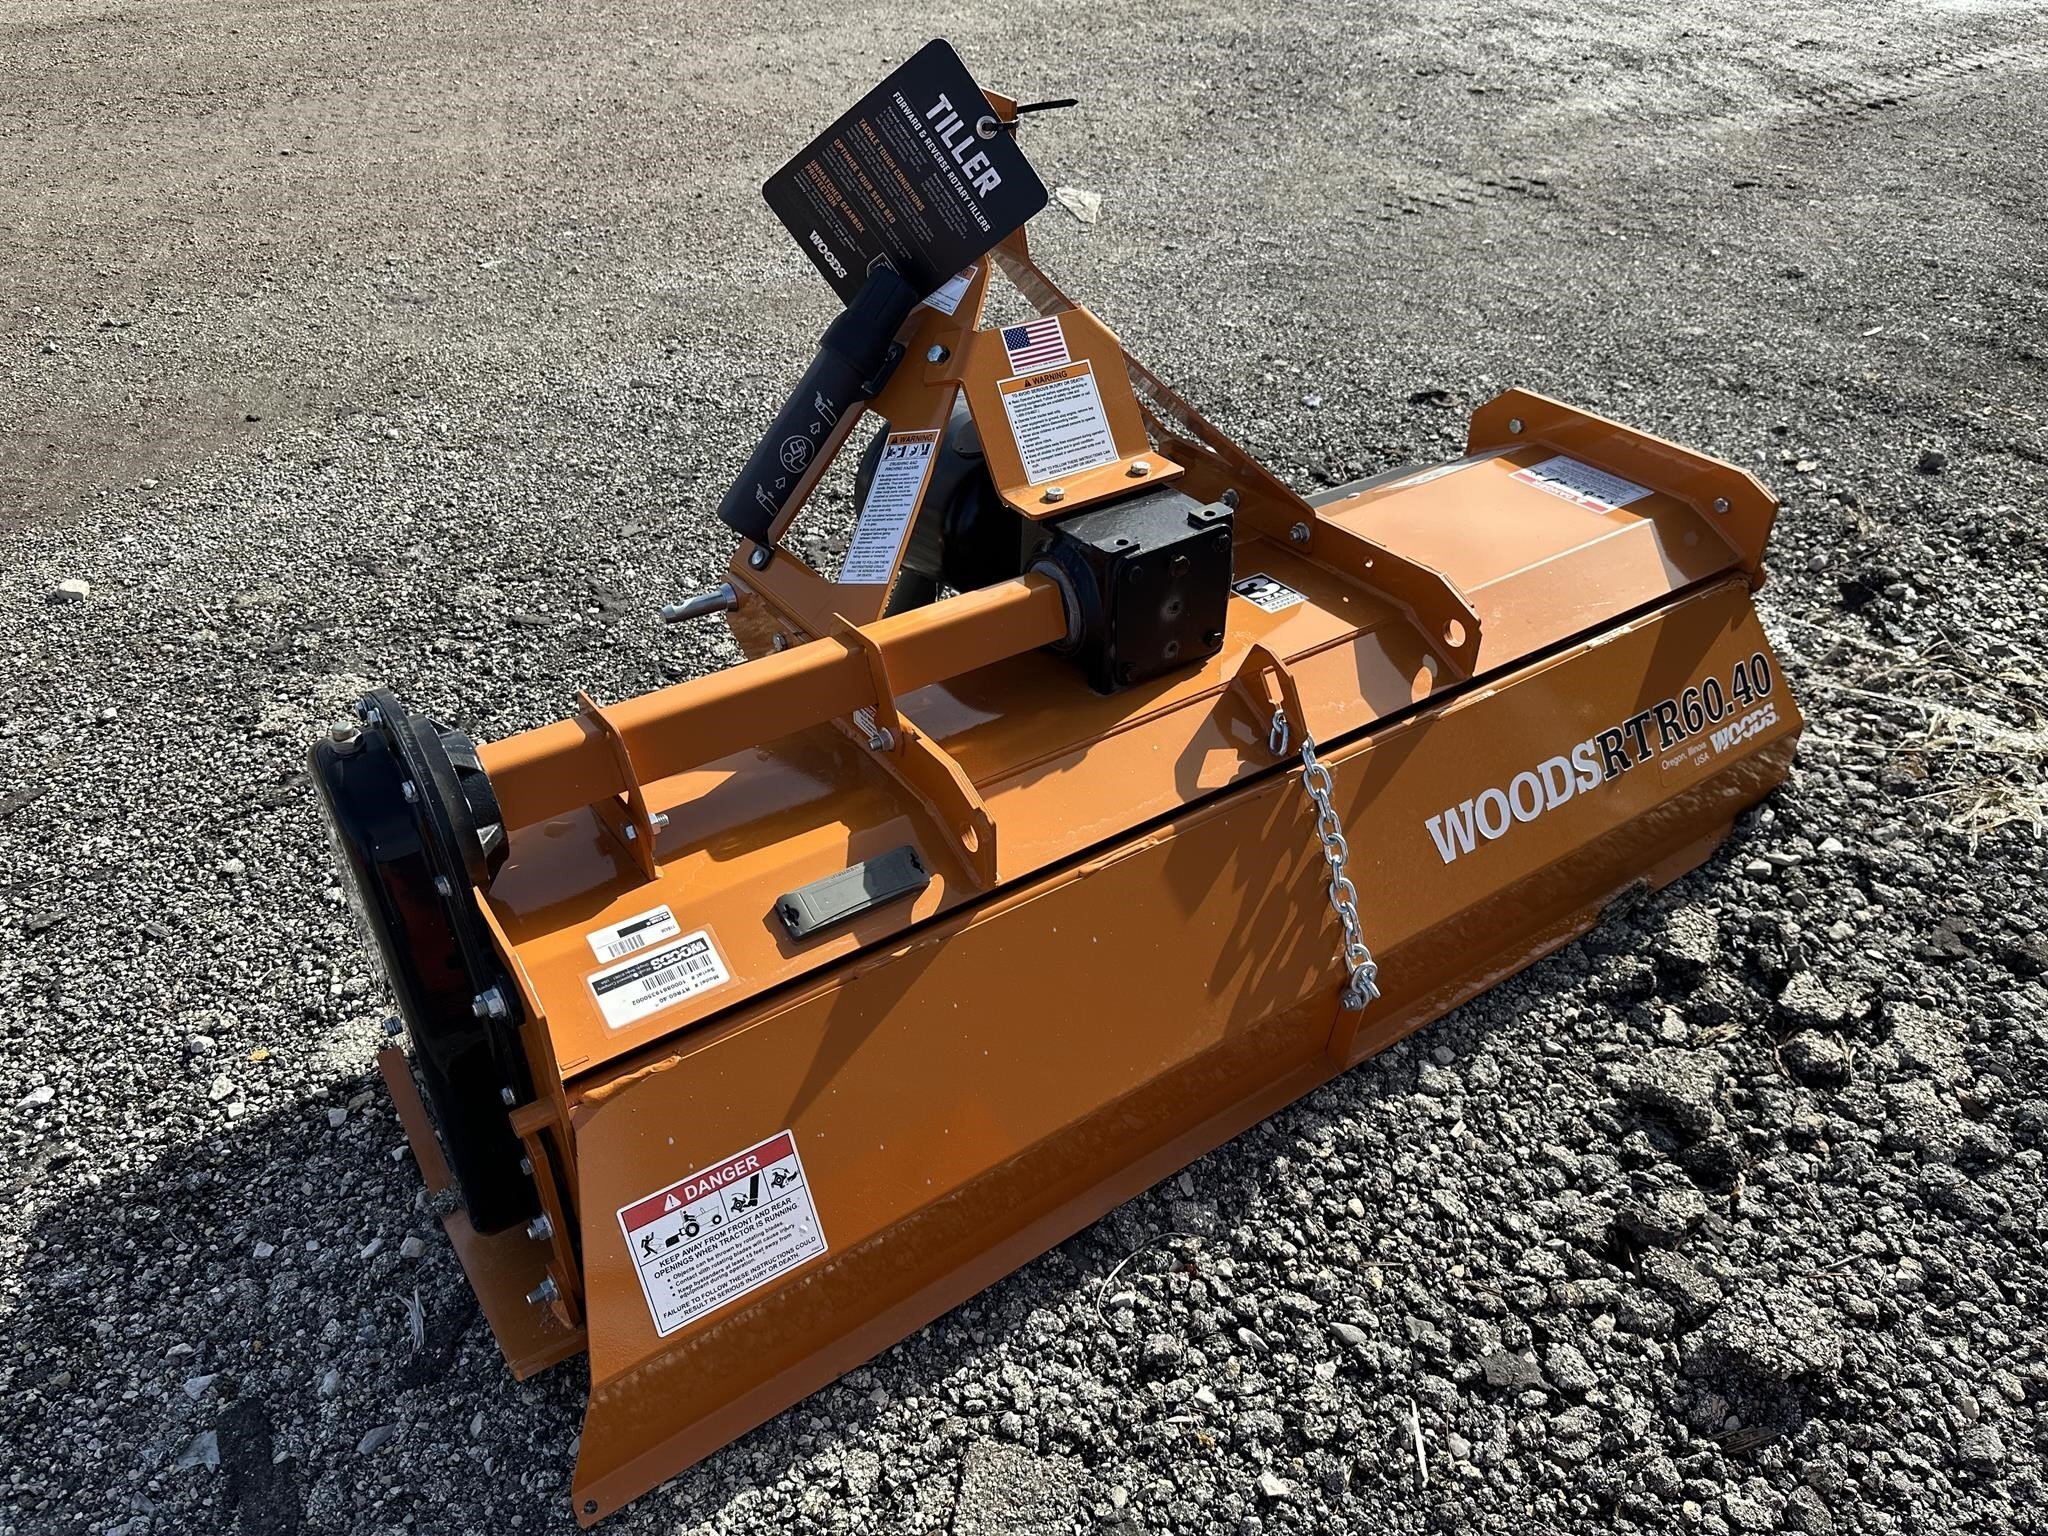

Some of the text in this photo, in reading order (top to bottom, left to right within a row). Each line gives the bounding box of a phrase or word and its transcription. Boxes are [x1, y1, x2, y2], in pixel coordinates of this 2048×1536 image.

[859, 118, 925, 211] TACKLE TOUGH CONDITIONS
[893, 92, 922, 130] FORWARD
[919, 130, 927, 138] &
[924, 138, 950, 172] REVERSE
[947, 171, 970, 201] ROTARY
[968, 201, 990, 232] TILLERS
[927, 95, 1000, 196] TILLER
[805, 164, 837, 207] PROTECTION
[809, 160, 842, 201] UNMATCHED
[840, 201, 865, 233] GEARBOX
[834, 139, 896, 224] OPTIMIZE YOUR SEED BED
[810, 230, 847, 278] WOODS
[1031, 386, 1049, 394] SERIOUS
[1032, 370, 1067, 384] WARNING
[900, 434, 933, 443] WARNING
[1236, 577, 1281, 599] 3
[1694, 752, 1710, 767] USA
[651, 942, 706, 970] WOODS
[696, 967, 715, 978] Serial
[700, 975, 719, 985] Model
[659, 987, 690, 1003] RTR60.40
[685, 1156, 759, 1200] DANGER
[654, 1255, 694, 1279] OPENINGS
[694, 1243, 718, 1258] WHEN
[719, 1224, 755, 1246] TRACTOR
[755, 1220, 764, 1228] IS
[659, 1197, 791, 1268] KEEP AWAY FROM FRONT AND REAR
[673, 1266, 695, 1279] Objects
[695, 1260, 706, 1268] can
[714, 1246, 735, 1259] thrown
[743, 1231, 765, 1244] rotating
[663, 1301, 690, 1318] FAILURE
[691, 1296, 701, 1304] TO
[701, 1282, 728, 1299] FOLLOW
[729, 1271, 749, 1284] THESE
[750, 1248, 794, 1273] INSTRUCTIONS
[795, 1236, 816, 1250] COULD
[675, 1272, 698, 1287] Contact
[711, 1255, 733, 1268] rotating
[733, 1246, 752, 1257] blades
[752, 1239, 762, 1247] will
[763, 1231, 779, 1242] cause
[677, 1284, 693, 1294] Keep
[693, 1268, 724, 1286] bystanders
[731, 1257, 745, 1266] least
[753, 1247, 764, 1255] feet
[765, 1240, 778, 1250] away
[779, 1233, 792, 1242] from
[679, 1281, 709, 1299] equipment
[710, 1272, 729, 1284] during
[684, 1299, 708, 1315] RESULT
[717, 1281, 745, 1298] SERIOUS
[745, 1269, 767, 1284] INJURY
[768, 1263, 778, 1272] OR
